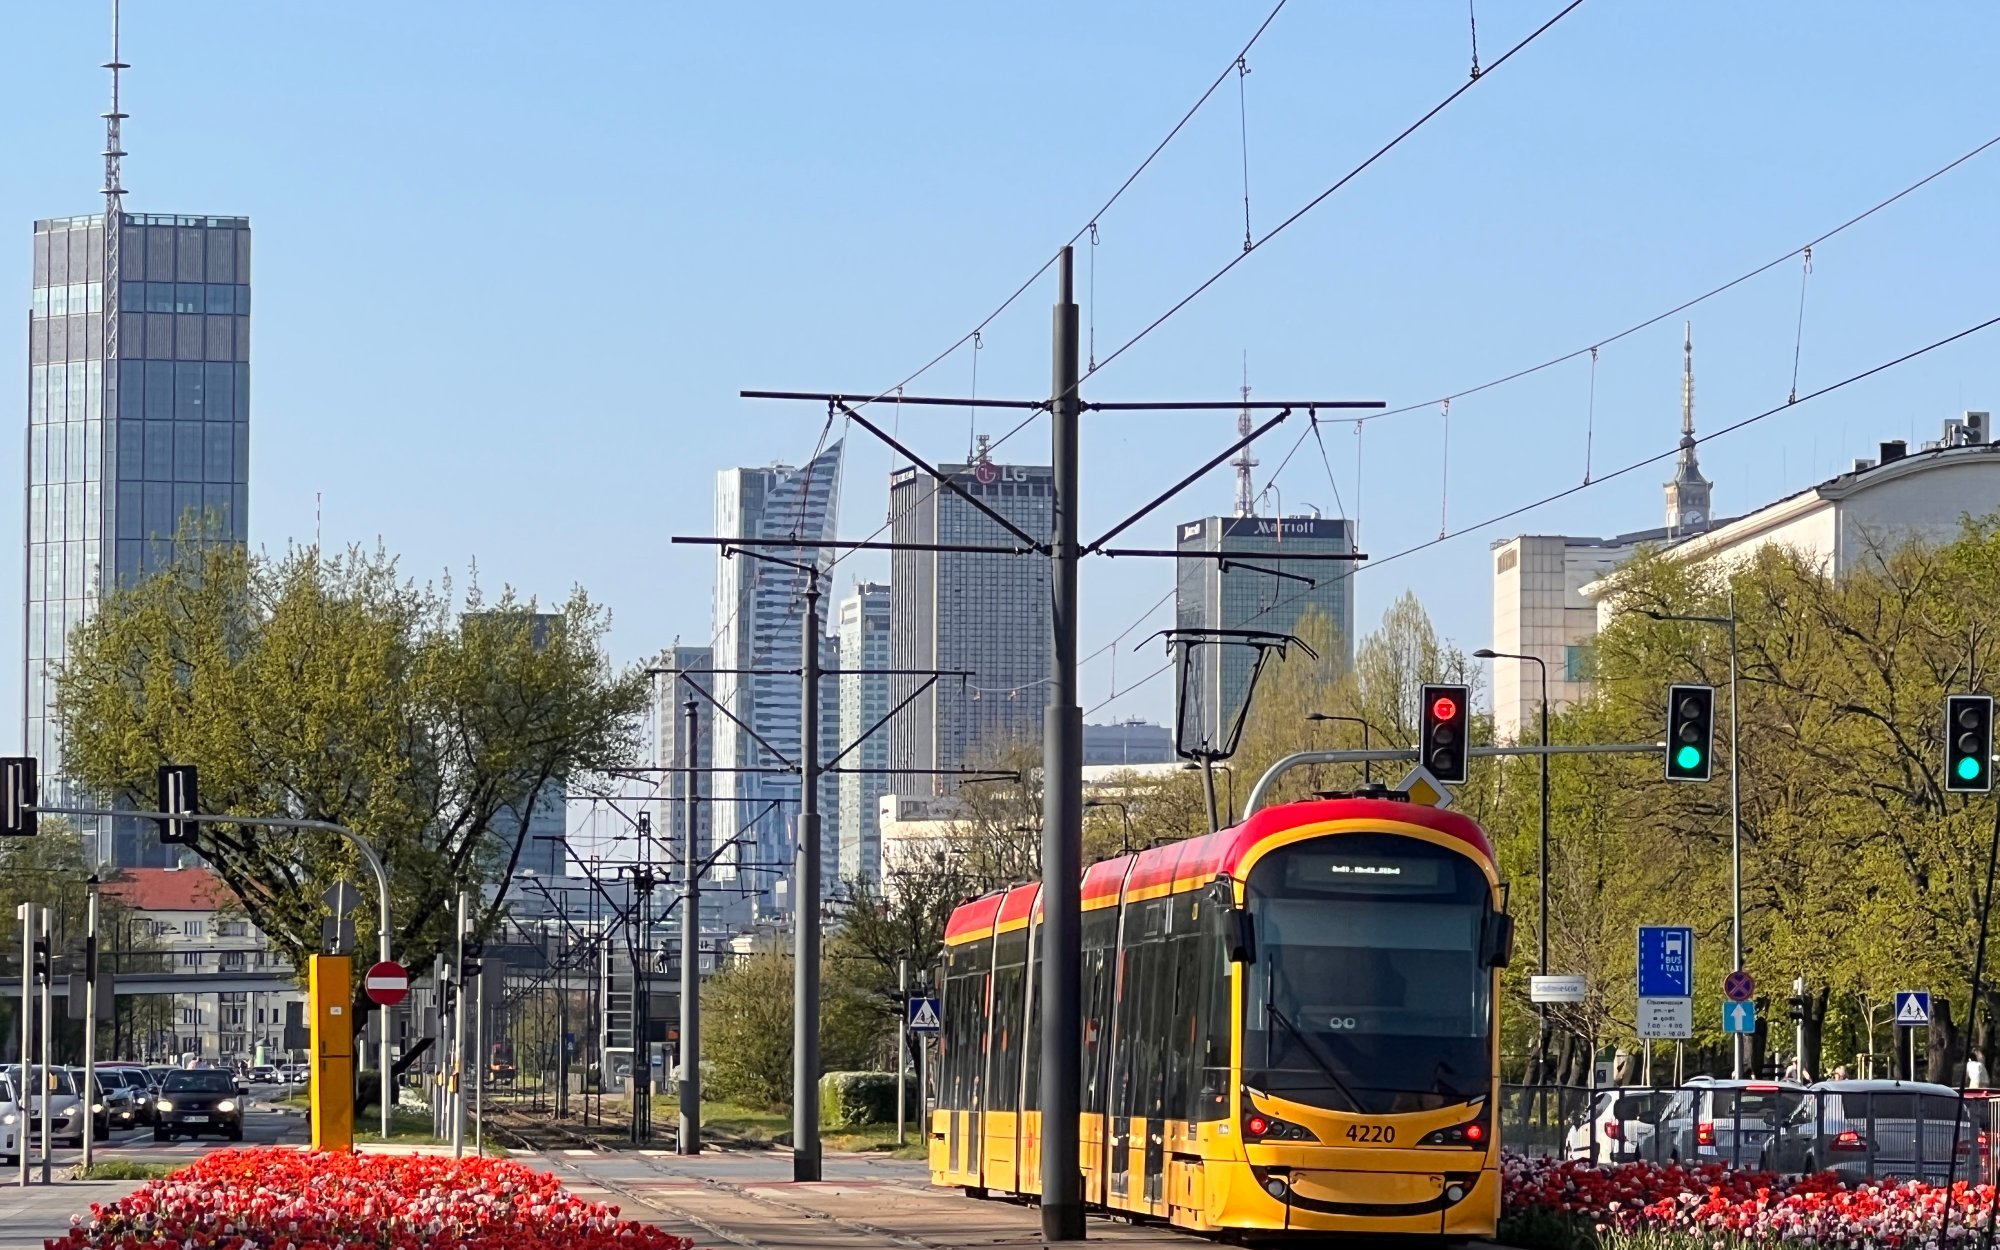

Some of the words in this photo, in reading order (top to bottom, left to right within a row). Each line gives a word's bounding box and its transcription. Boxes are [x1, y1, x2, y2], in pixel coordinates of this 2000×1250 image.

[1002, 465, 1026, 482] LG
[1253, 520, 1314, 534] Marriott
[1665, 955, 1682, 964] BUS
[1665, 964, 1683, 972] TAXI
[1345, 1124, 1396, 1144] 4220
